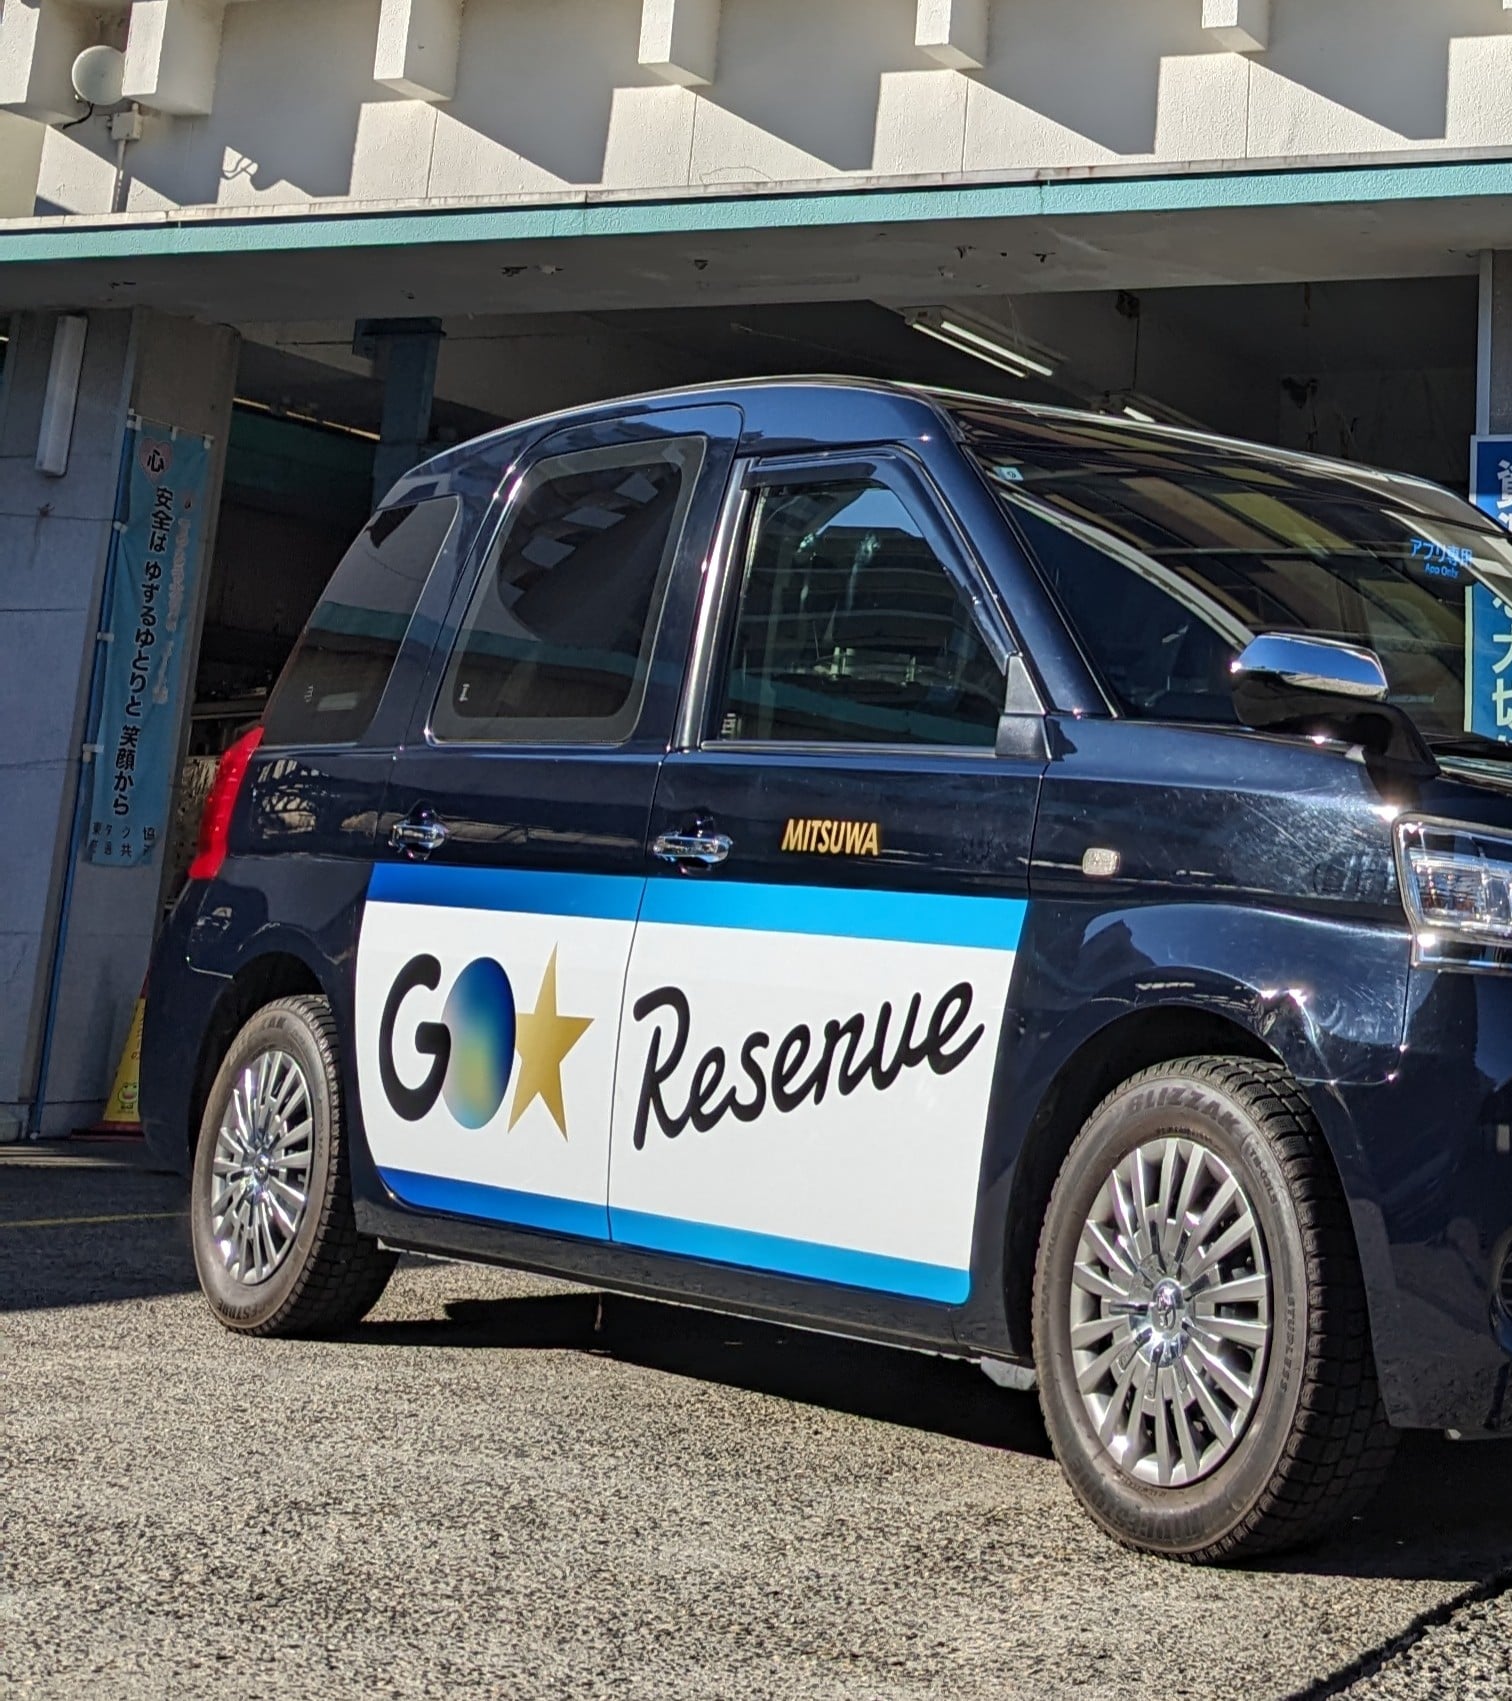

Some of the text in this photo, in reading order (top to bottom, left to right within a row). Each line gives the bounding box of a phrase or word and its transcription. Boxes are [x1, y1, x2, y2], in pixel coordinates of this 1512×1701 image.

[1409, 537, 1473, 568] アプリ専用
[1424, 563, 1459, 579] App Only
[113, 449, 174, 816] 心 安全は ゆずるゆとりと 笑顔から
[781, 818, 879, 857] MITSUWA
[378, 953, 985, 1151] GO Reserve
[1123, 1086, 1241, 1136] BLIZZAK
